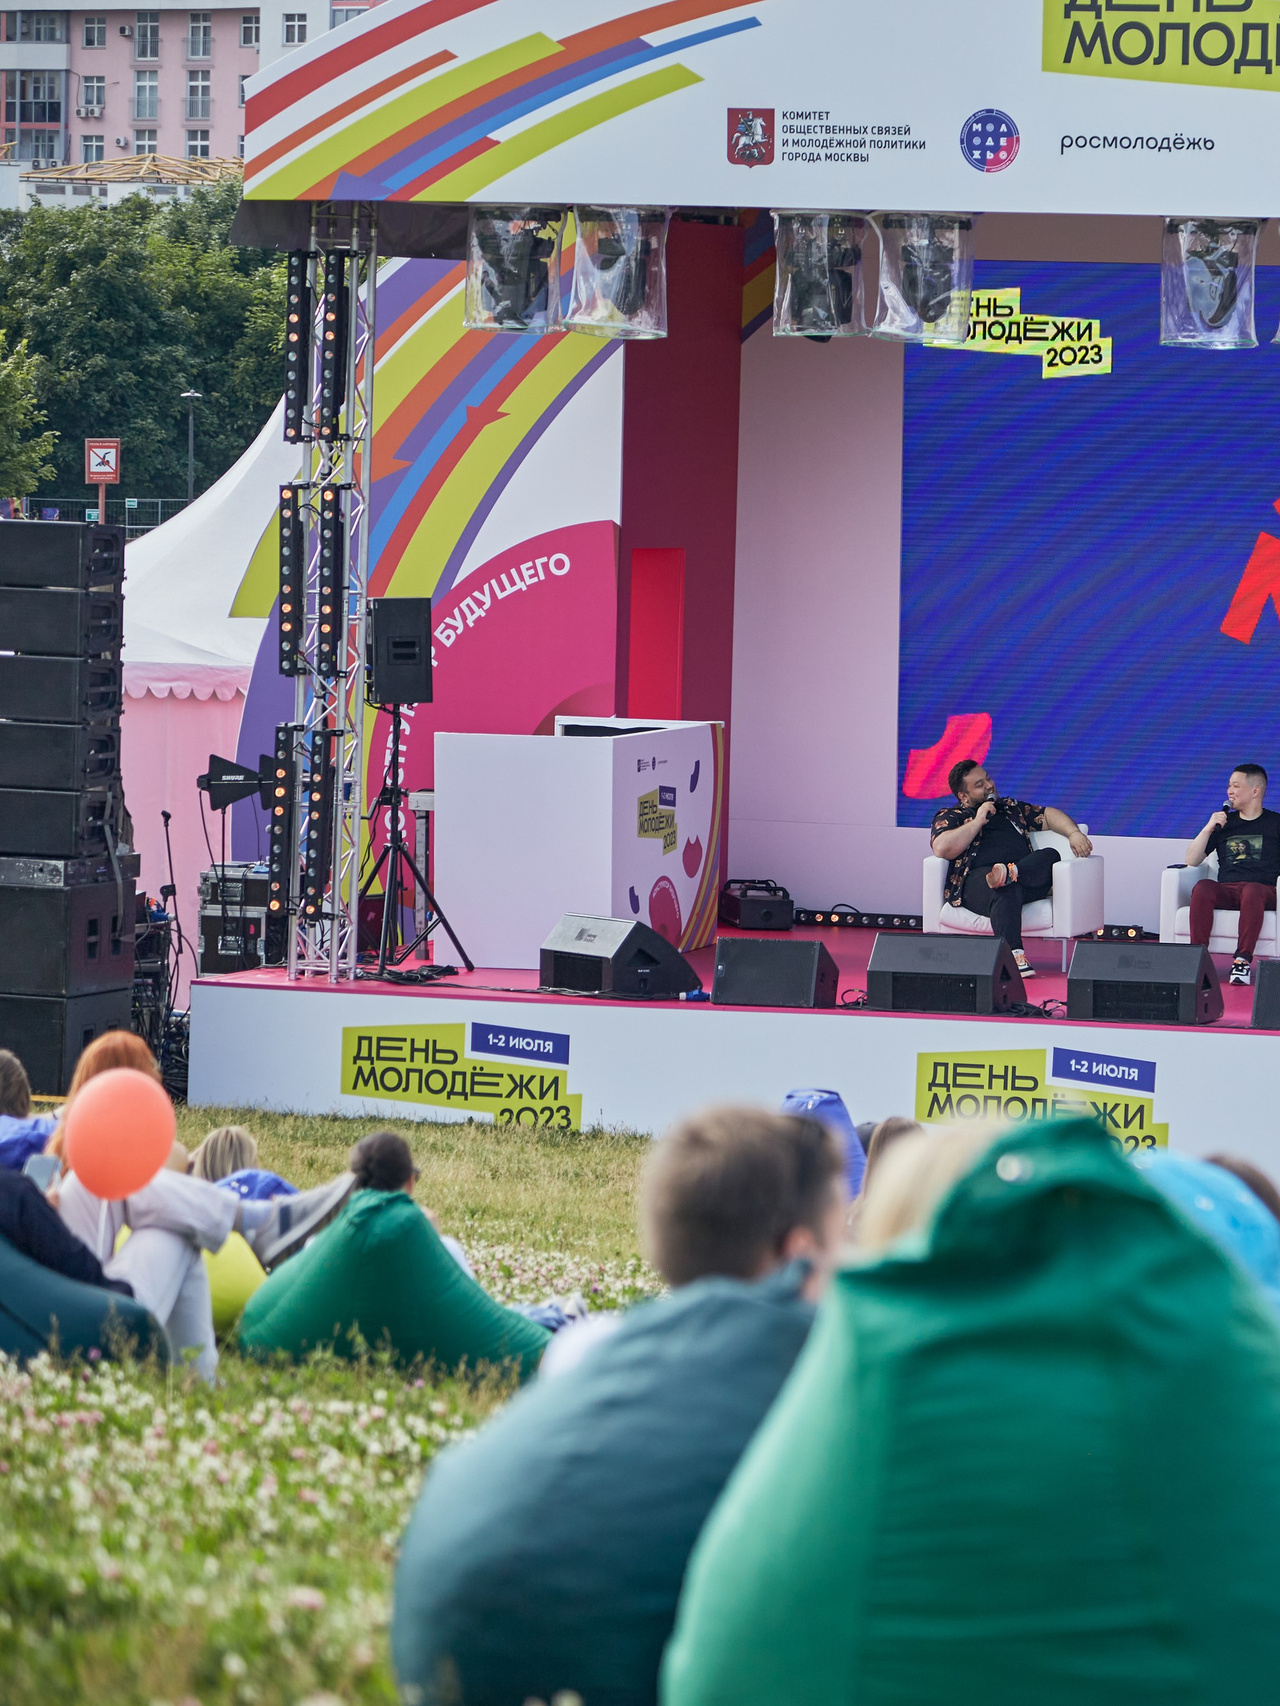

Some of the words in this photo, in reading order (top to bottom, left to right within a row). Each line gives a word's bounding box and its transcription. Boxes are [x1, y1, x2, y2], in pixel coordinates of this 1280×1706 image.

[782, 111, 830, 121] КОМИТЕТ
[782, 124, 868, 135] ОБЩЕСТВЕННЫХ
[871, 125, 911, 136] СВЯЗЕЙ
[782, 138, 789, 148] И
[791, 138, 866, 150] МОЛОДЁЖНОЙ
[869, 139, 926, 150] ПОЛИТИКИ
[1060, 133, 1215, 155] росмолодёжь
[781, 152, 822, 163] ГОРОДА
[824, 153, 869, 163] МОСКВЫ
[966, 316, 1093, 344] ЛОДЁЖИ
[1046, 344, 1103, 368] 2023
[433, 553, 571, 648] БУДУЩЕГО
[221, 774, 245, 782] SHURE
[352, 1035, 459, 1066] ДЕНЬ
[487, 1033, 506, 1047] 1-2
[509, 1035, 553, 1054] ИЮЛЯ
[352, 1065, 560, 1101] МОЛОДЁЖИ
[927, 1061, 1039, 1092] ДЕНЬ
[1069, 1058, 1089, 1074] 1-2
[1092, 1060, 1139, 1081] ИЮЛЯ
[499, 1105, 572, 1131] 2023
